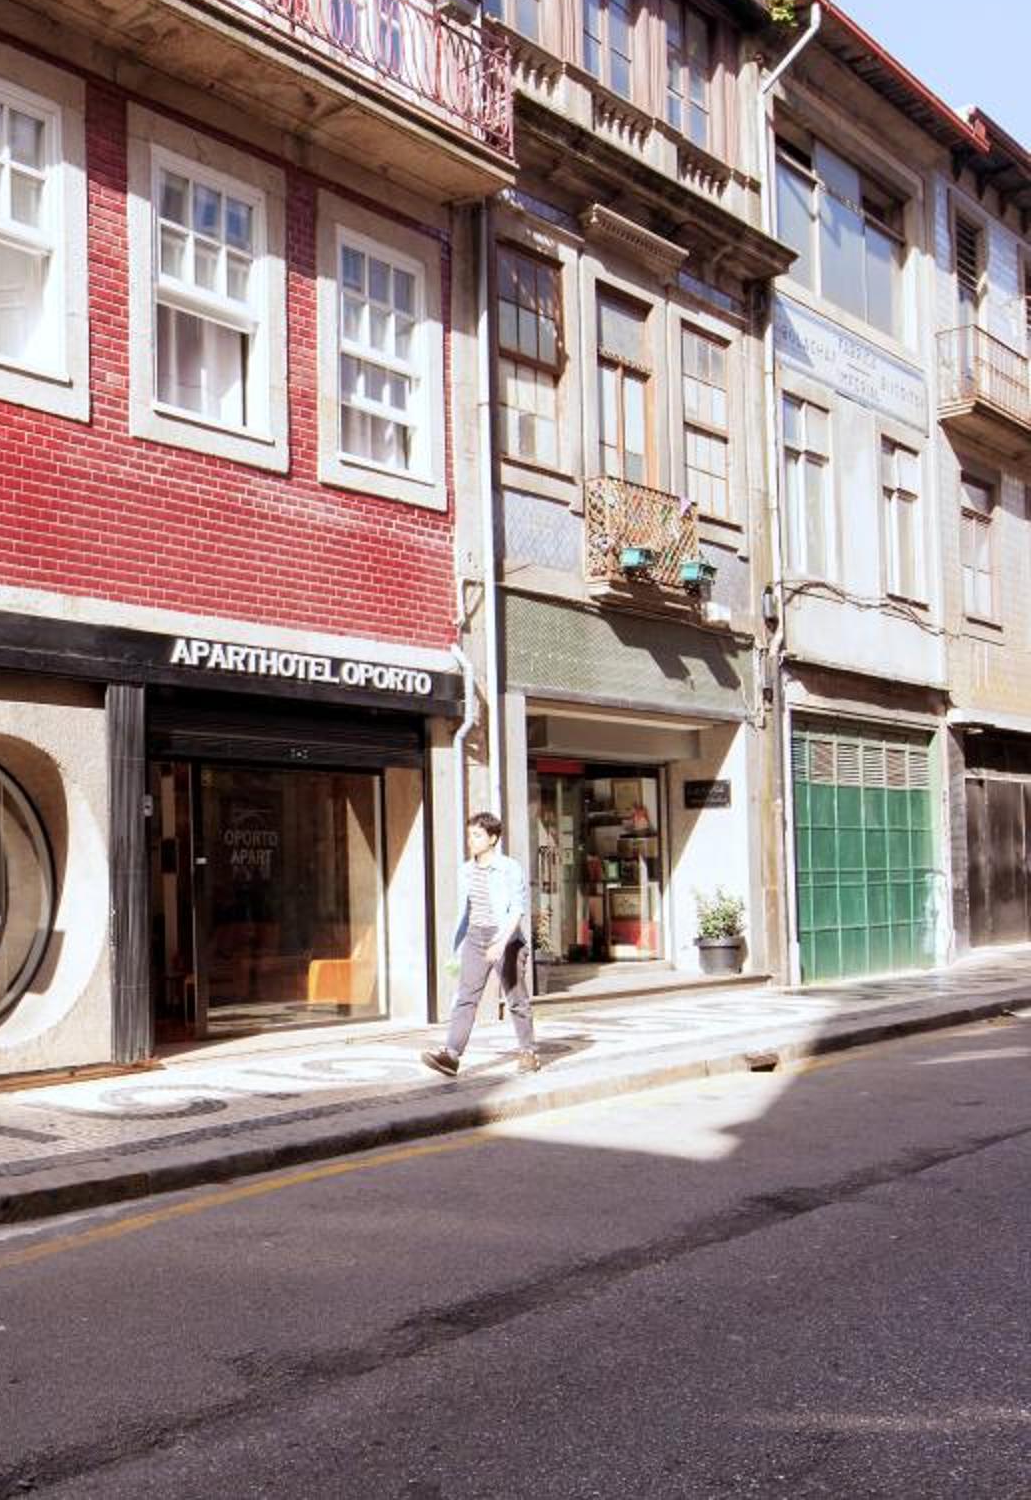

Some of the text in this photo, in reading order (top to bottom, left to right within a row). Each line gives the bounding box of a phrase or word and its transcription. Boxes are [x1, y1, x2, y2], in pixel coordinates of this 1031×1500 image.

[170, 638, 432, 695] APARTHOTEL OPORTO
[224, 830, 278, 846] OPORTO
[230, 849, 273, 868] APART
